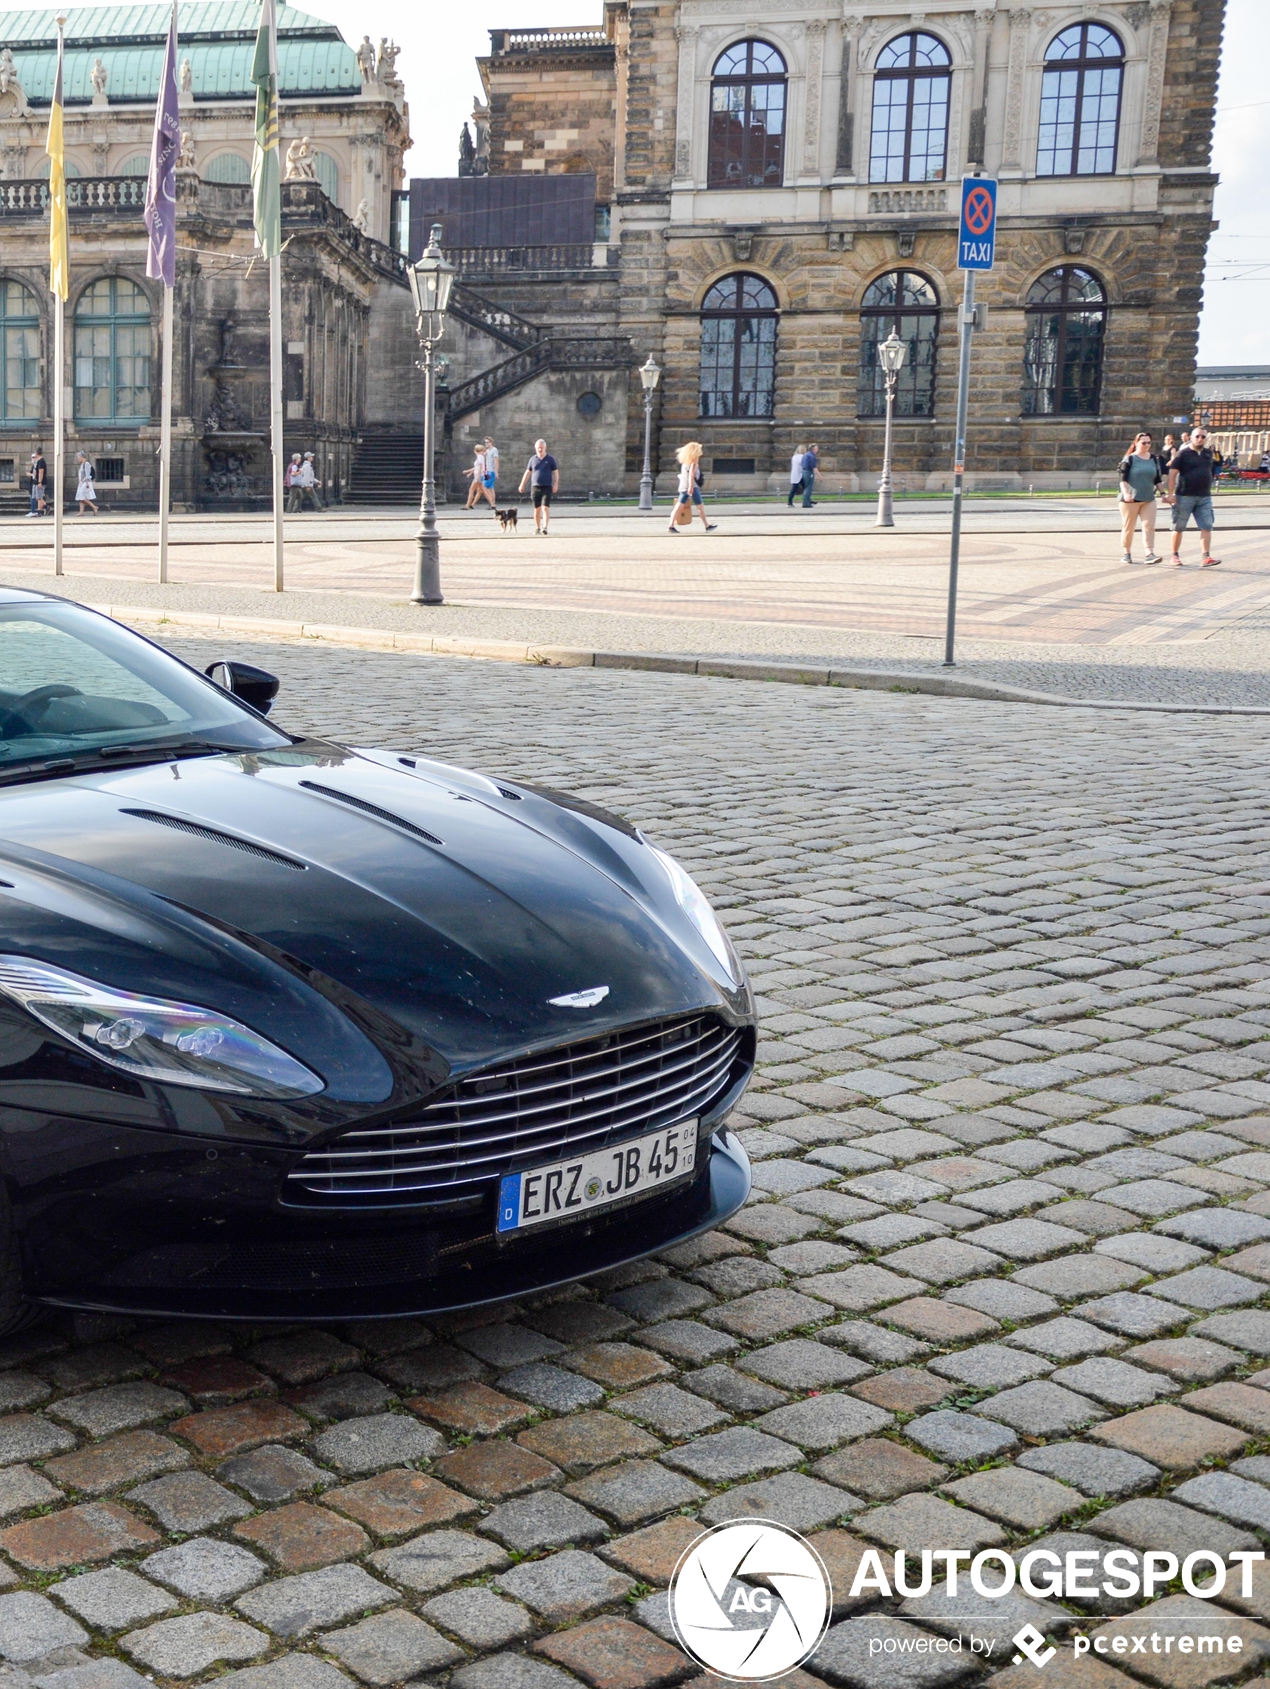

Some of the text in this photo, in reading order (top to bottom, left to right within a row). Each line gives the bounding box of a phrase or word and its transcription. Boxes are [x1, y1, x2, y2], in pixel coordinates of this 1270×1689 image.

[962, 242, 990, 261] TAXI
[683, 1127, 694, 1140] 04
[683, 1153, 693, 1167] 10
[504, 1132, 679, 1221] D ERZ JB 45
